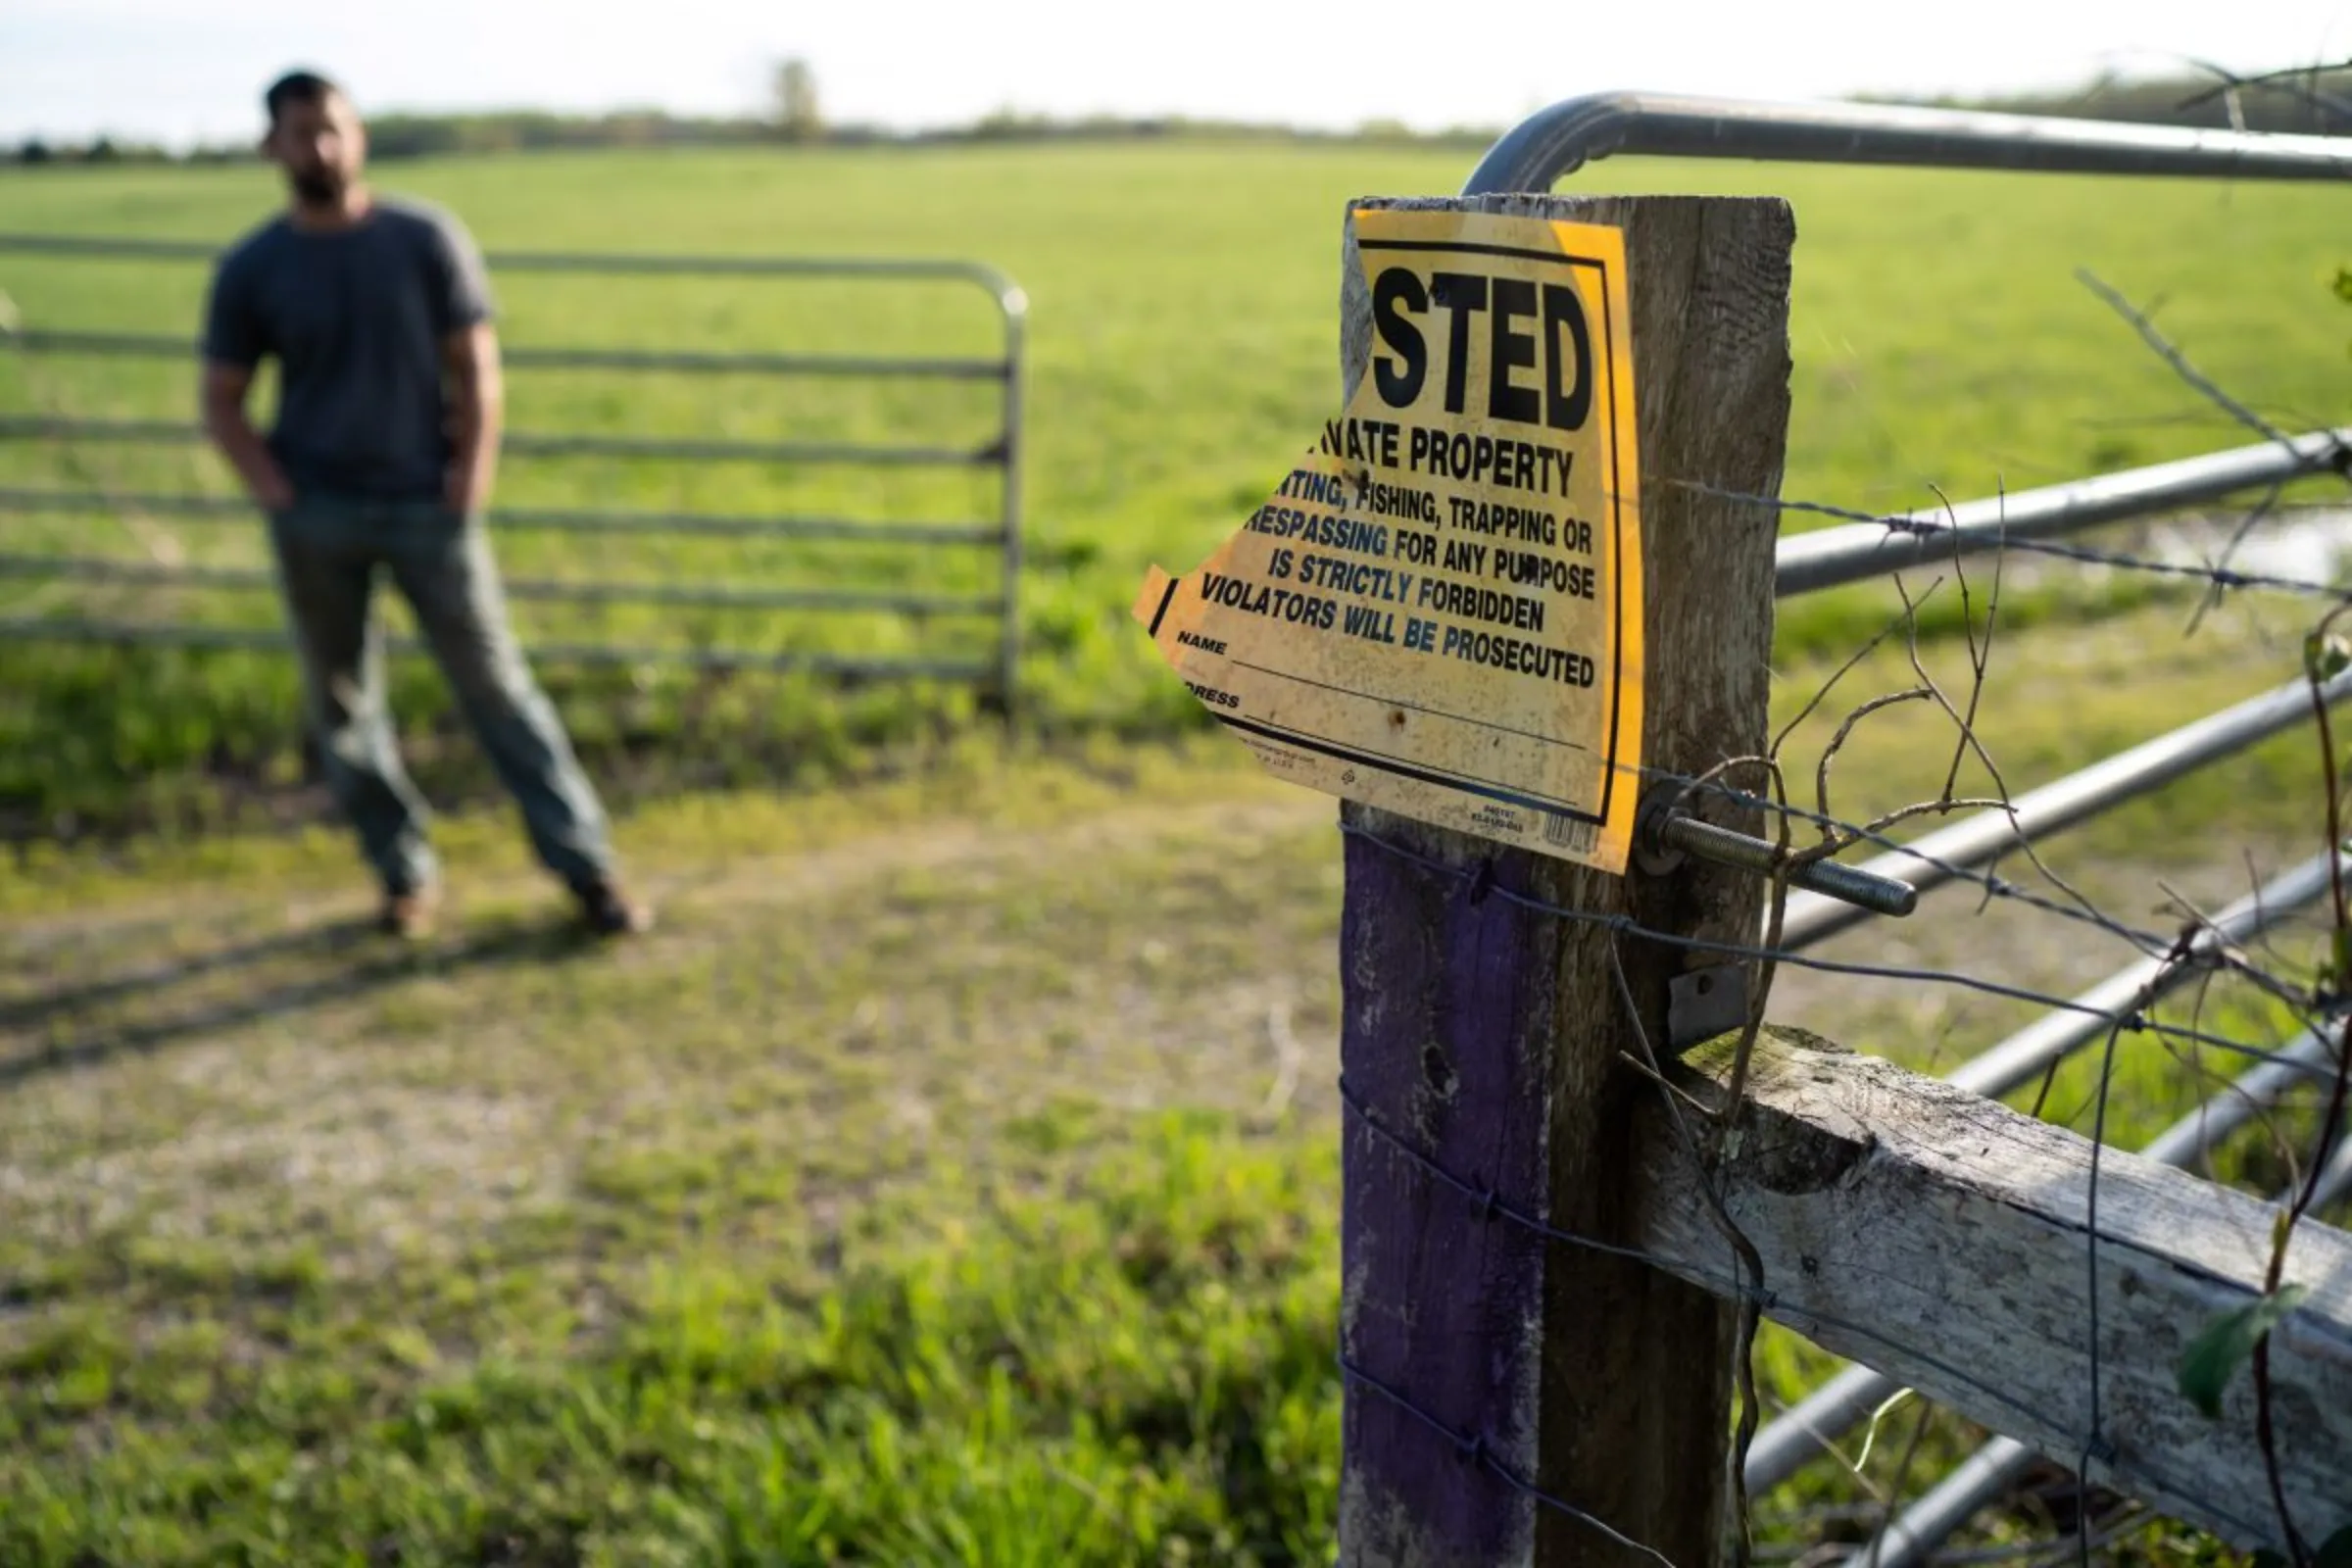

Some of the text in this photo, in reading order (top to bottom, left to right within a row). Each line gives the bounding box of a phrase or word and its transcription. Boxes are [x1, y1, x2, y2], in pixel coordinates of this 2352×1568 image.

[1373, 267, 1592, 431] STED
[1410, 428, 1575, 497] PROPERTY
[1357, 479, 1442, 529] FISHING,
[1449, 497, 1557, 545] TRAPPING
[1563, 519, 1592, 555] OR
[1268, 548, 1544, 632] IS STRICTLY FORBIDDEN
[1395, 529, 1436, 566] FOR
[1444, 541, 1487, 577] ANY
[1494, 551, 1594, 599] PURPOSE
[1177, 630, 1227, 656] NAME
[1201, 572, 1594, 687] VIOLATORS WILL BE PROSECUTED
